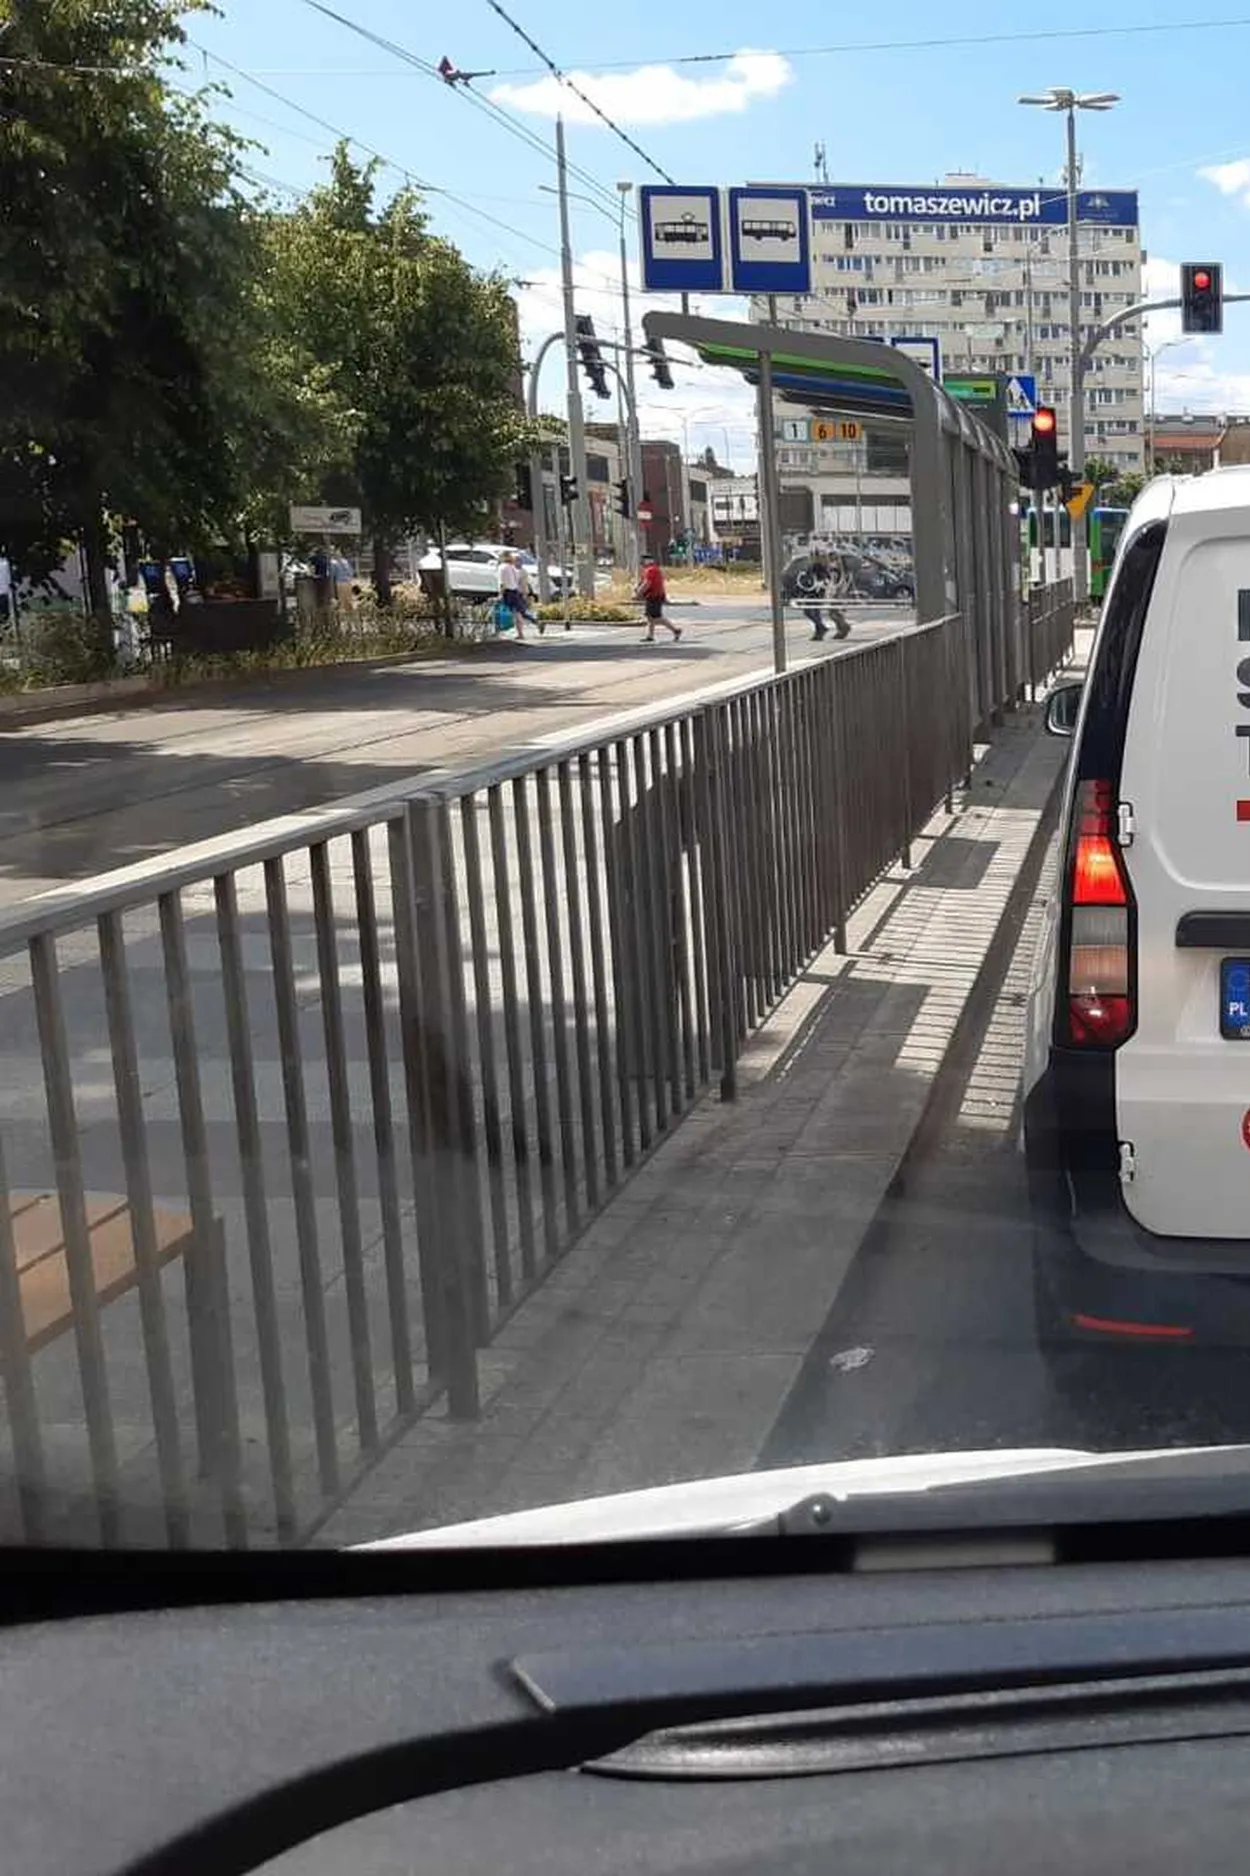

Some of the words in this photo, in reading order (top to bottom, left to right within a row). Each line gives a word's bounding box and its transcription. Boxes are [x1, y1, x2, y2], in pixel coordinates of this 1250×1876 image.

[863, 192, 1040, 220] tomaszewicz.pl
[819, 424, 827, 439] 6
[841, 423, 856, 438] 10
[1229, 1002, 1249, 1016] PL
